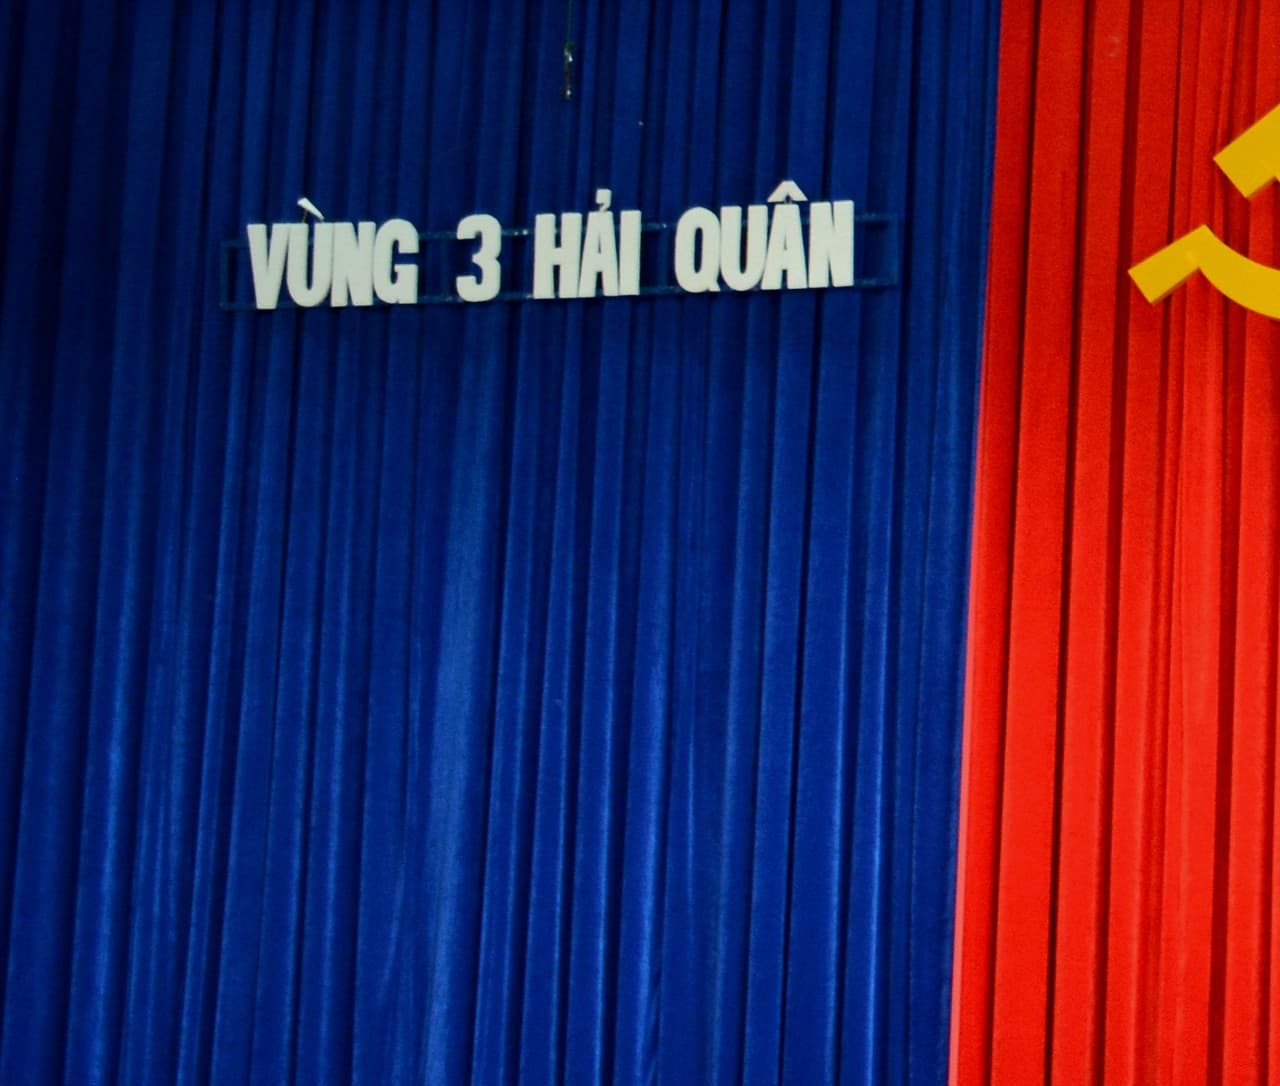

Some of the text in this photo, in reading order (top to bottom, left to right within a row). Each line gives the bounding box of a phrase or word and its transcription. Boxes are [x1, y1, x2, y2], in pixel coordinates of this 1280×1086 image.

[247, 180, 854, 310] VÙNG 3 HẢI QUÂN
